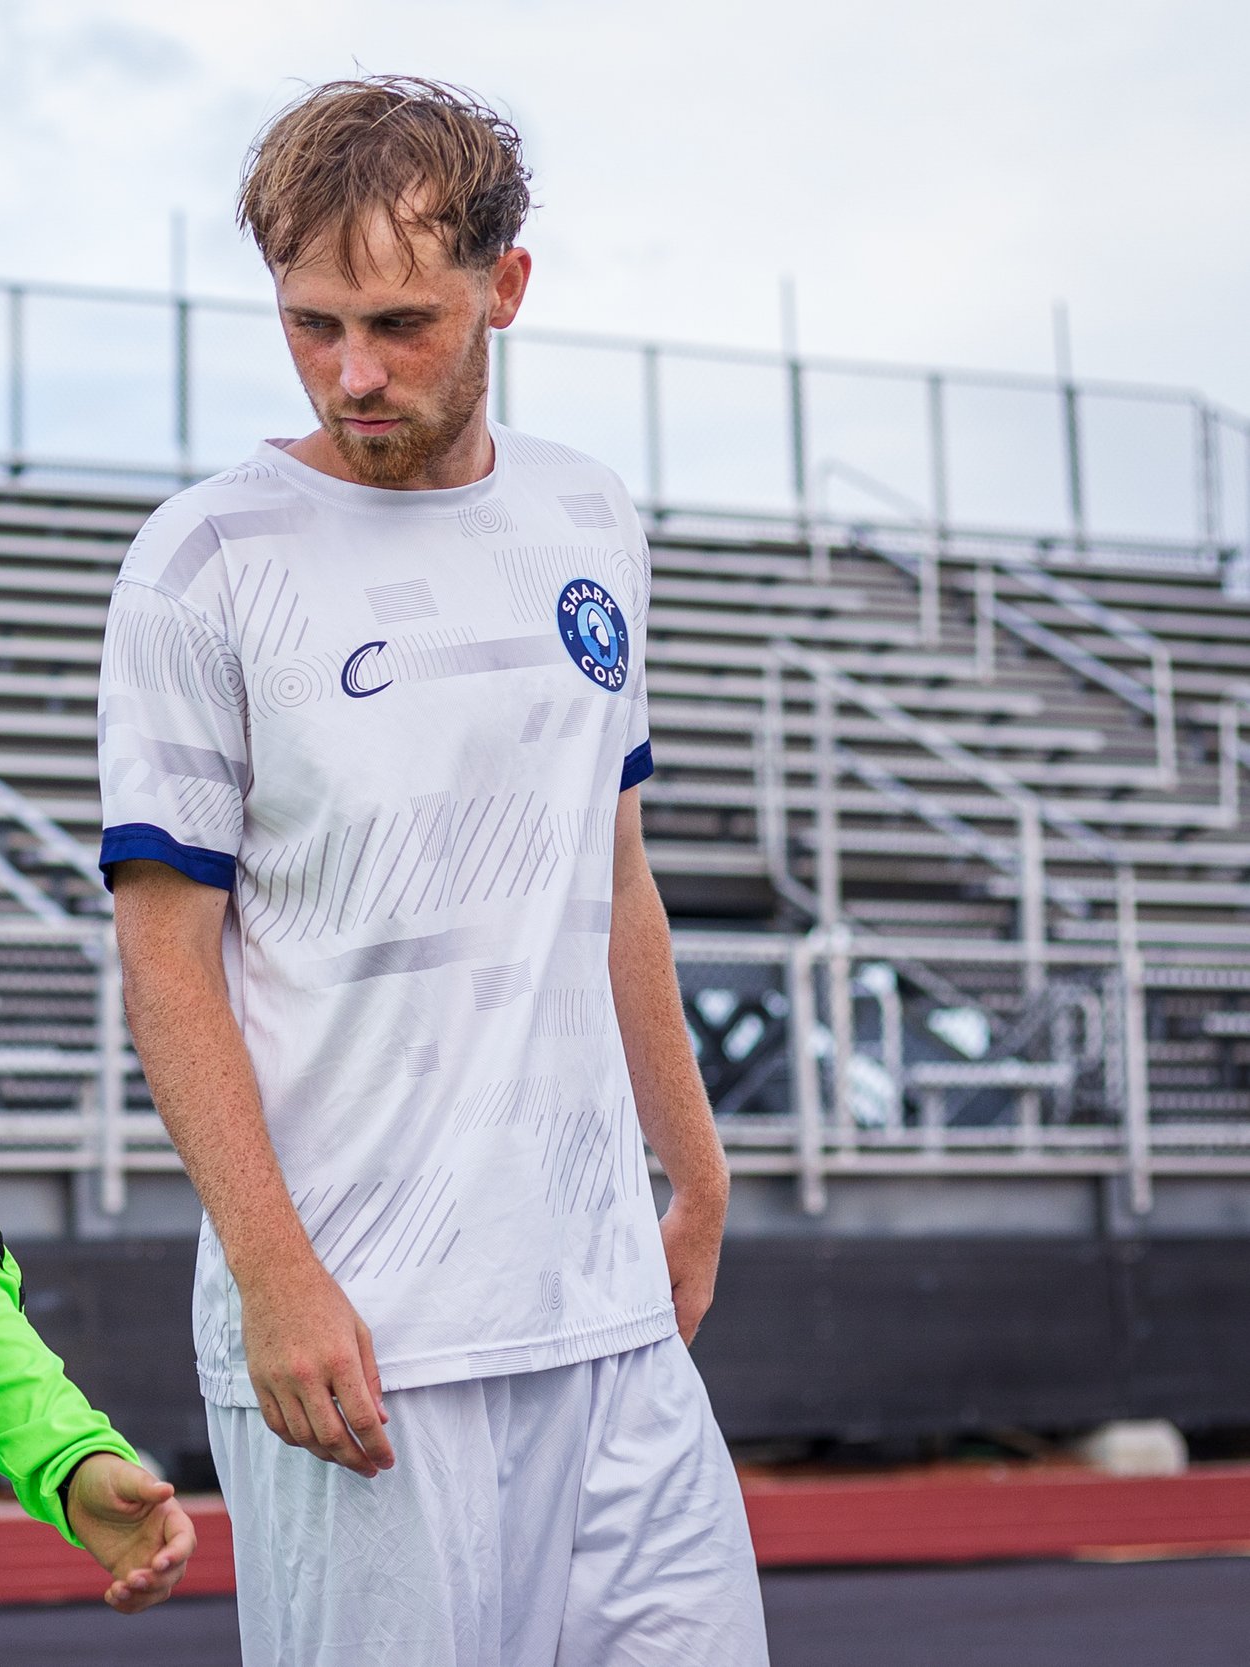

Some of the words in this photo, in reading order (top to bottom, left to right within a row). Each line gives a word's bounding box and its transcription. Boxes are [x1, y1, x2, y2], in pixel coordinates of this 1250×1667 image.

[562, 584, 616, 615] SHARK
[567, 630, 575, 641] F
[618, 630, 625, 642] C
[581, 655, 626, 687] COAST
